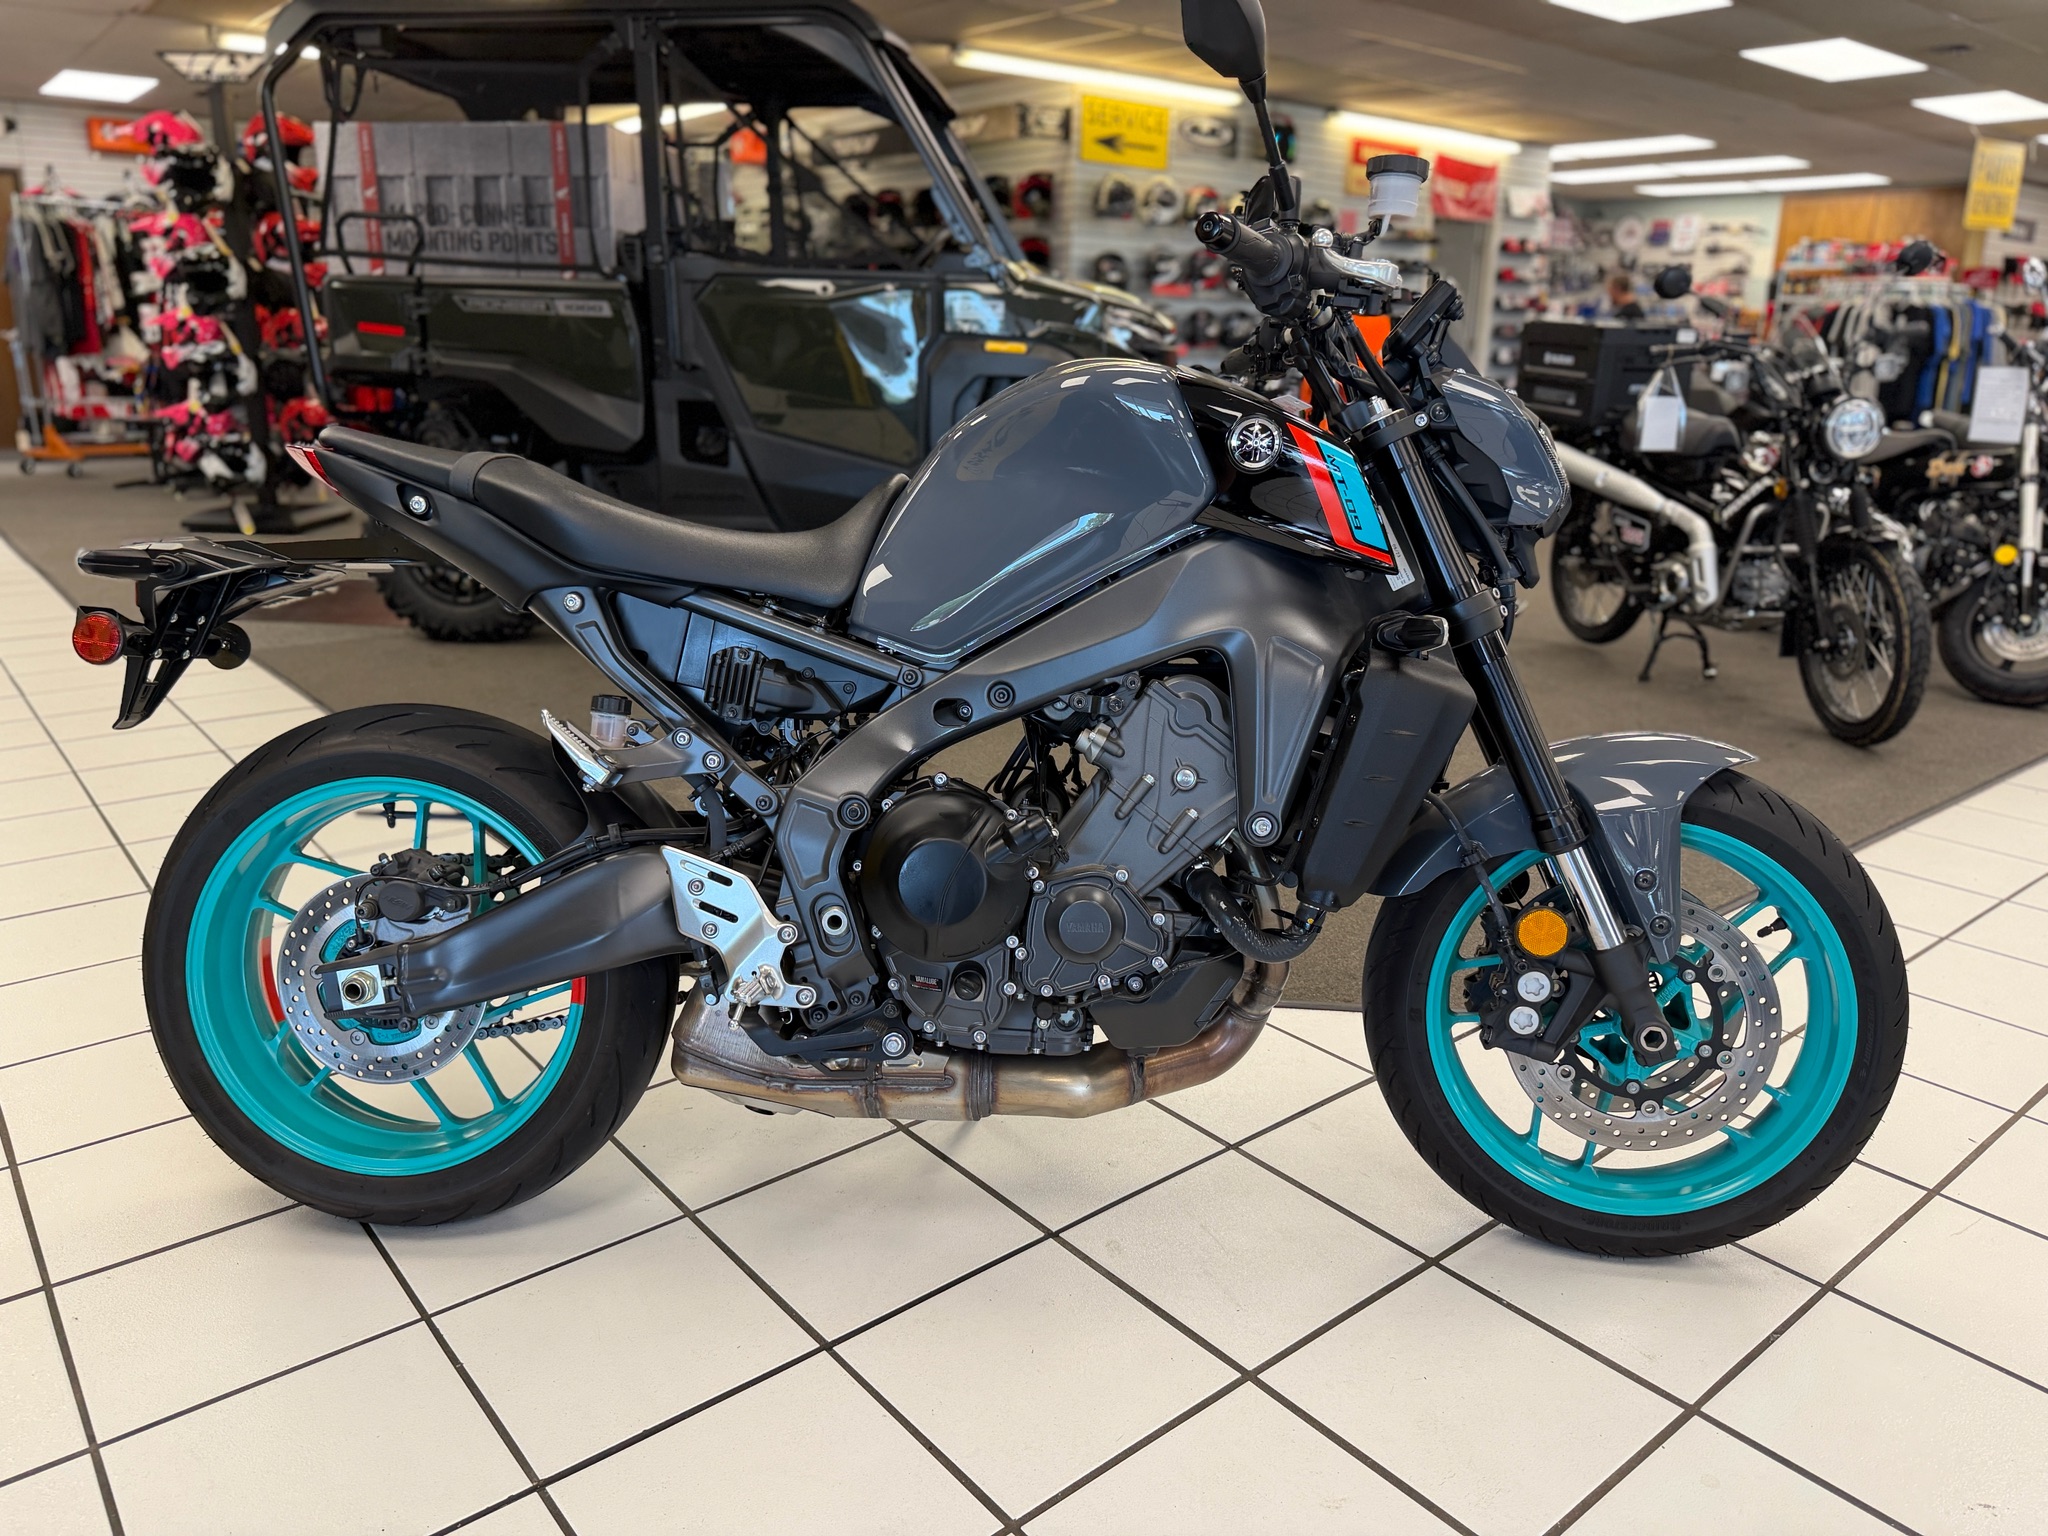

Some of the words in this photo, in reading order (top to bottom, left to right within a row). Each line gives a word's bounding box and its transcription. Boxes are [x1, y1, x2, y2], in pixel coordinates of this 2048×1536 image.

[1085, 101, 1165, 136] SERVICE
[386, 229, 482, 252] MONTING
[488, 231, 558, 255] POINTS
[1327, 453, 1362, 531] MT-09
[1066, 922, 1105, 933] YAMAHA
